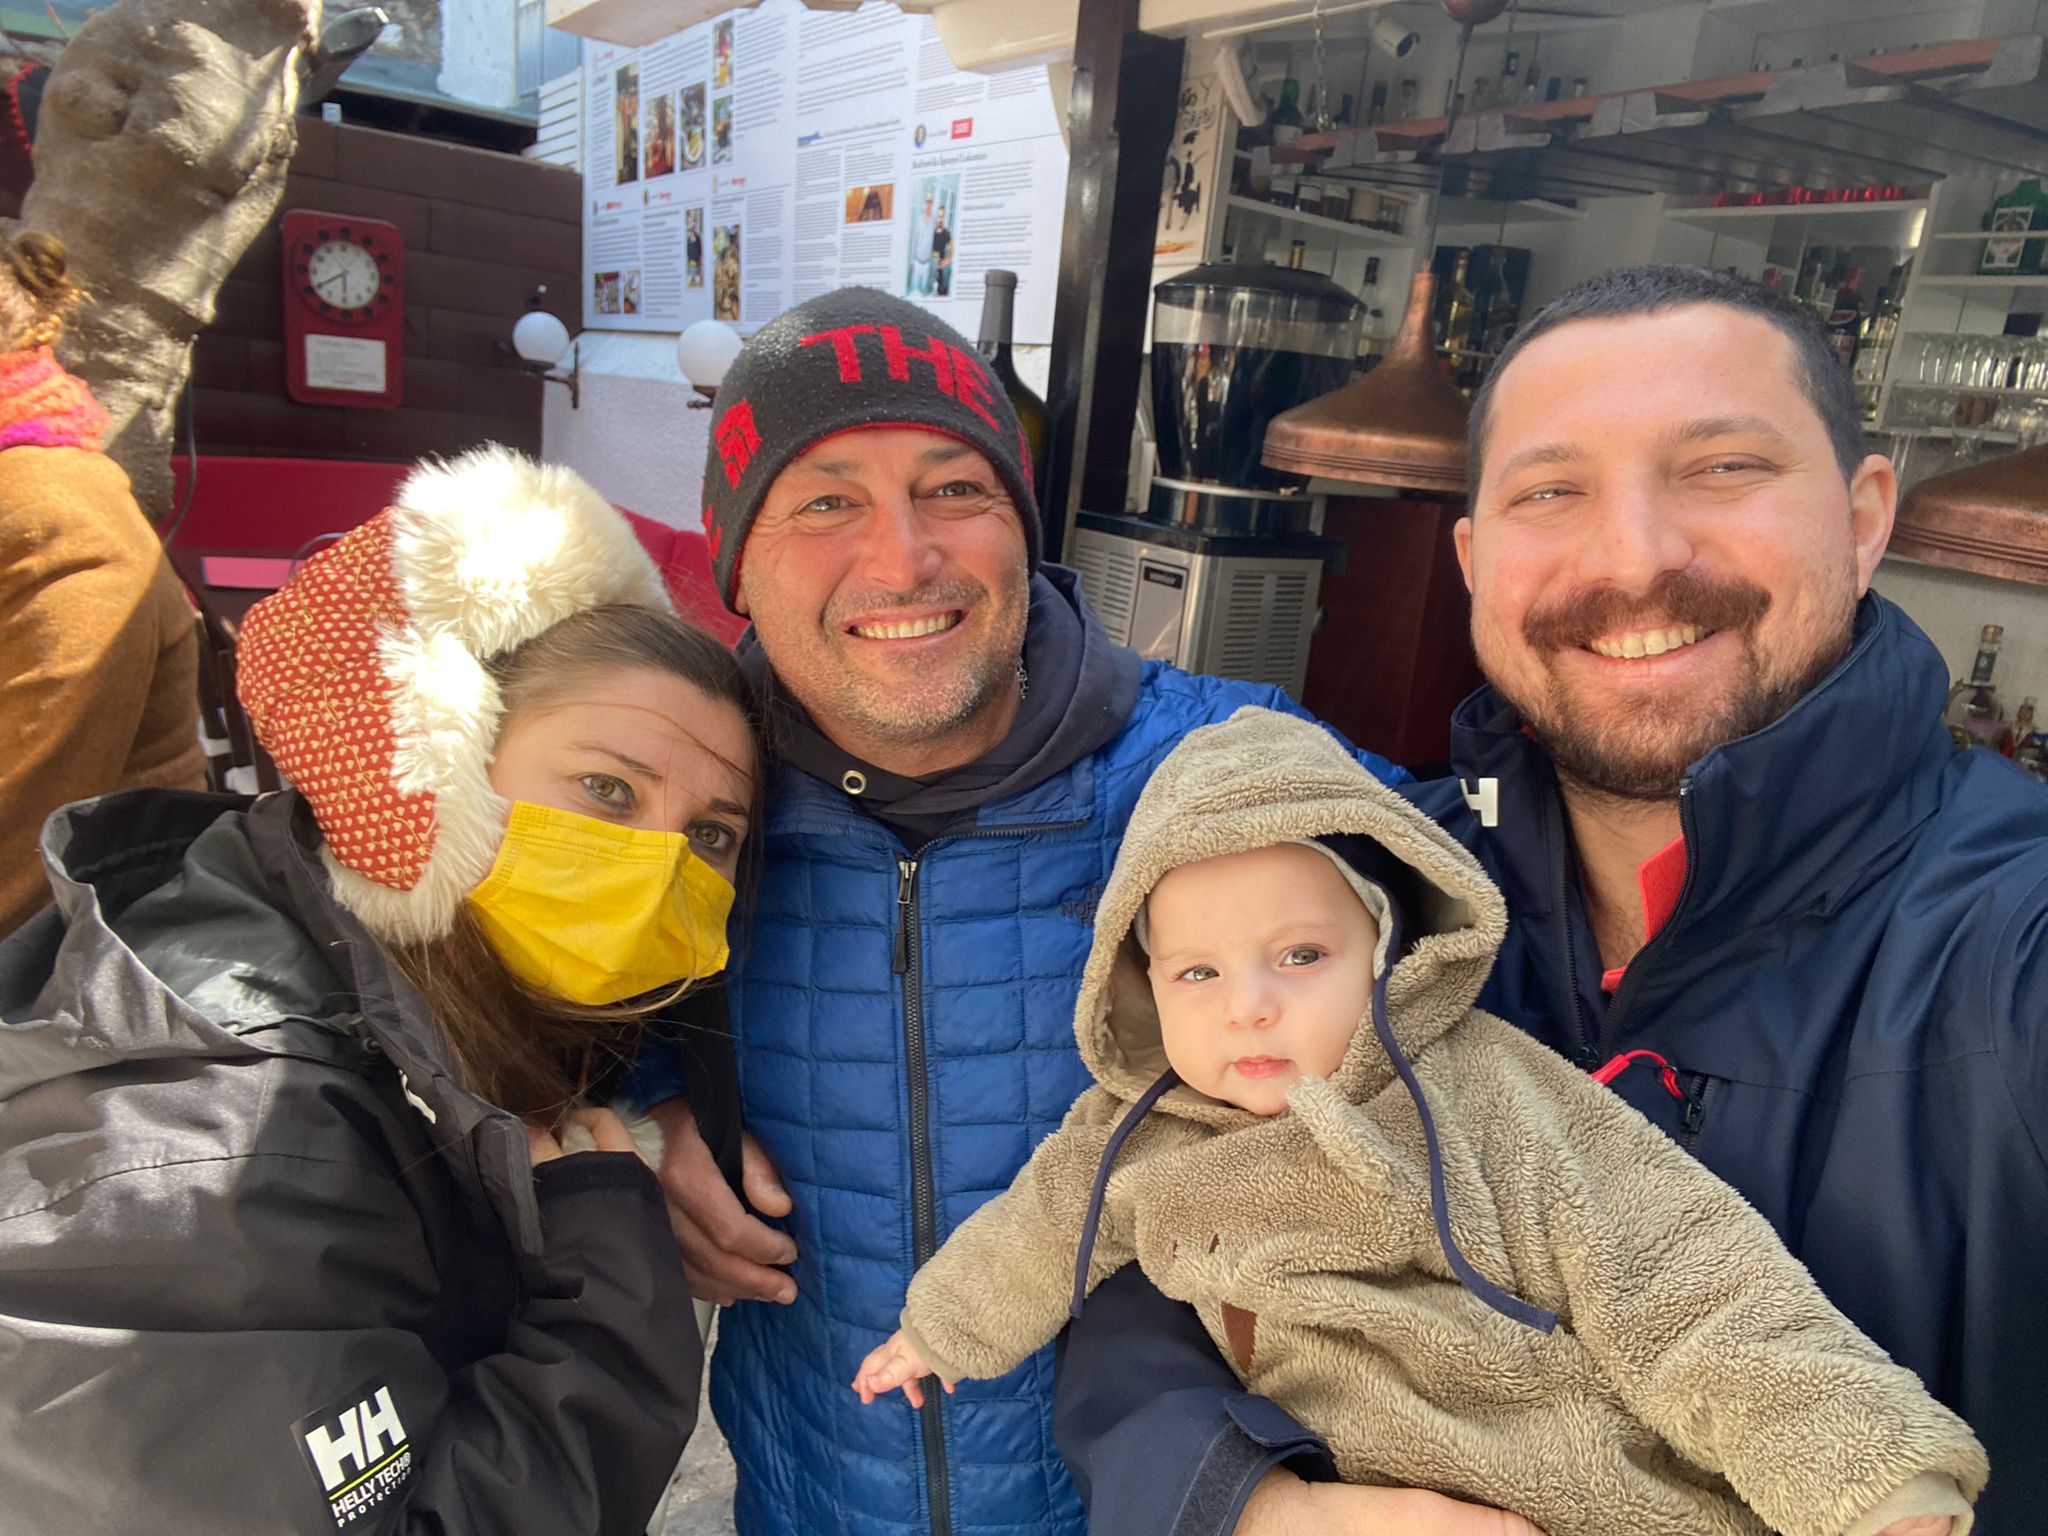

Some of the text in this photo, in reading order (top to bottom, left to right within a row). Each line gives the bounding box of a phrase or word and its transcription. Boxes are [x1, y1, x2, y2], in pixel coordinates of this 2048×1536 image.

[800, 324, 1000, 432] THE
[305, 1385, 407, 1491] HH
[331, 1478, 376, 1518] HELLY
